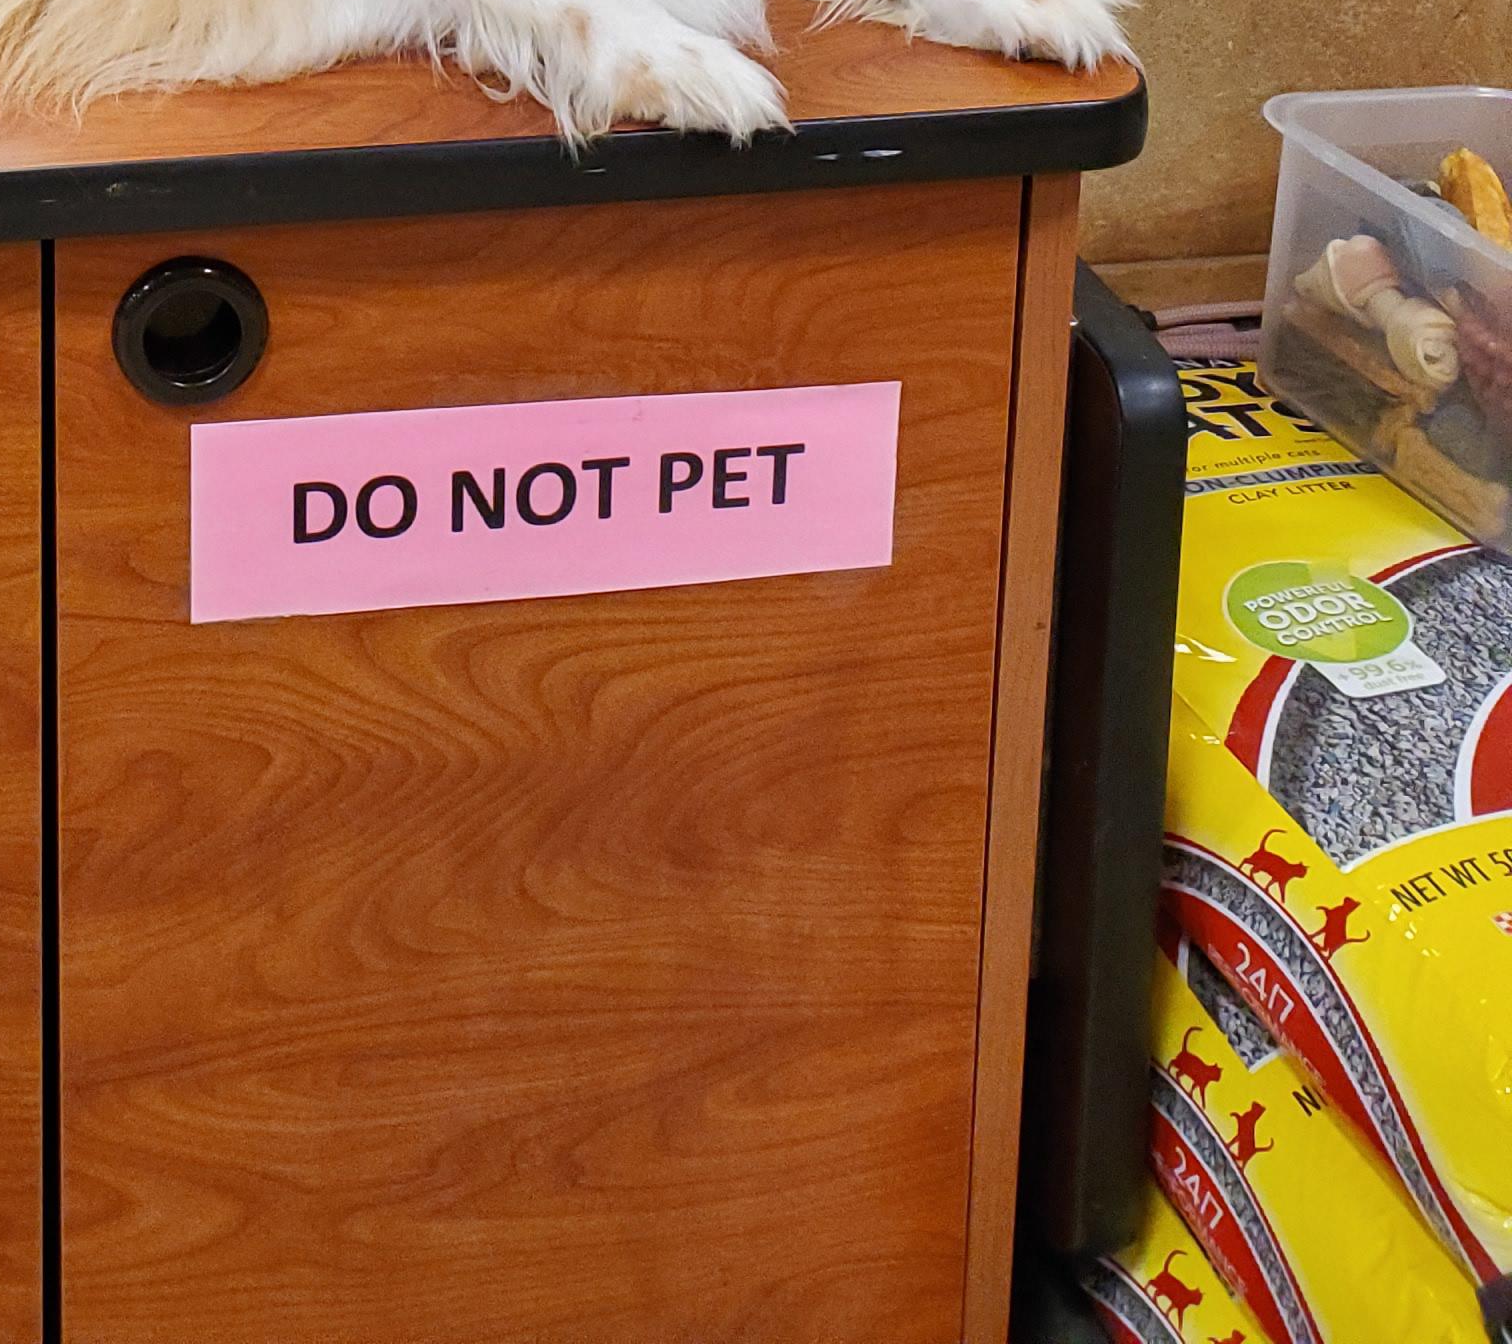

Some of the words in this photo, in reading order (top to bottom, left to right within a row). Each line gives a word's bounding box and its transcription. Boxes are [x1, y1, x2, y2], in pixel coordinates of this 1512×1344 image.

[1180, 372, 1269, 402] DY
[1214, 451, 1281, 469] multiple
[293, 475, 418, 544] DO
[451, 457, 630, 533] NOT
[659, 443, 805, 514] PET
[1184, 462, 1380, 493] ON-CLUMPING
[1228, 488, 1279, 504] CLAY
[1286, 481, 1356, 495] LITTER
[1244, 581, 1354, 613] POWERFUL
[1258, 591, 1375, 630] ODOR
[1277, 612, 1392, 645] CONTROL
[1390, 872, 1447, 912] NET
[1439, 857, 1491, 889] WT
[1235, 942, 1295, 1024] 24/7
